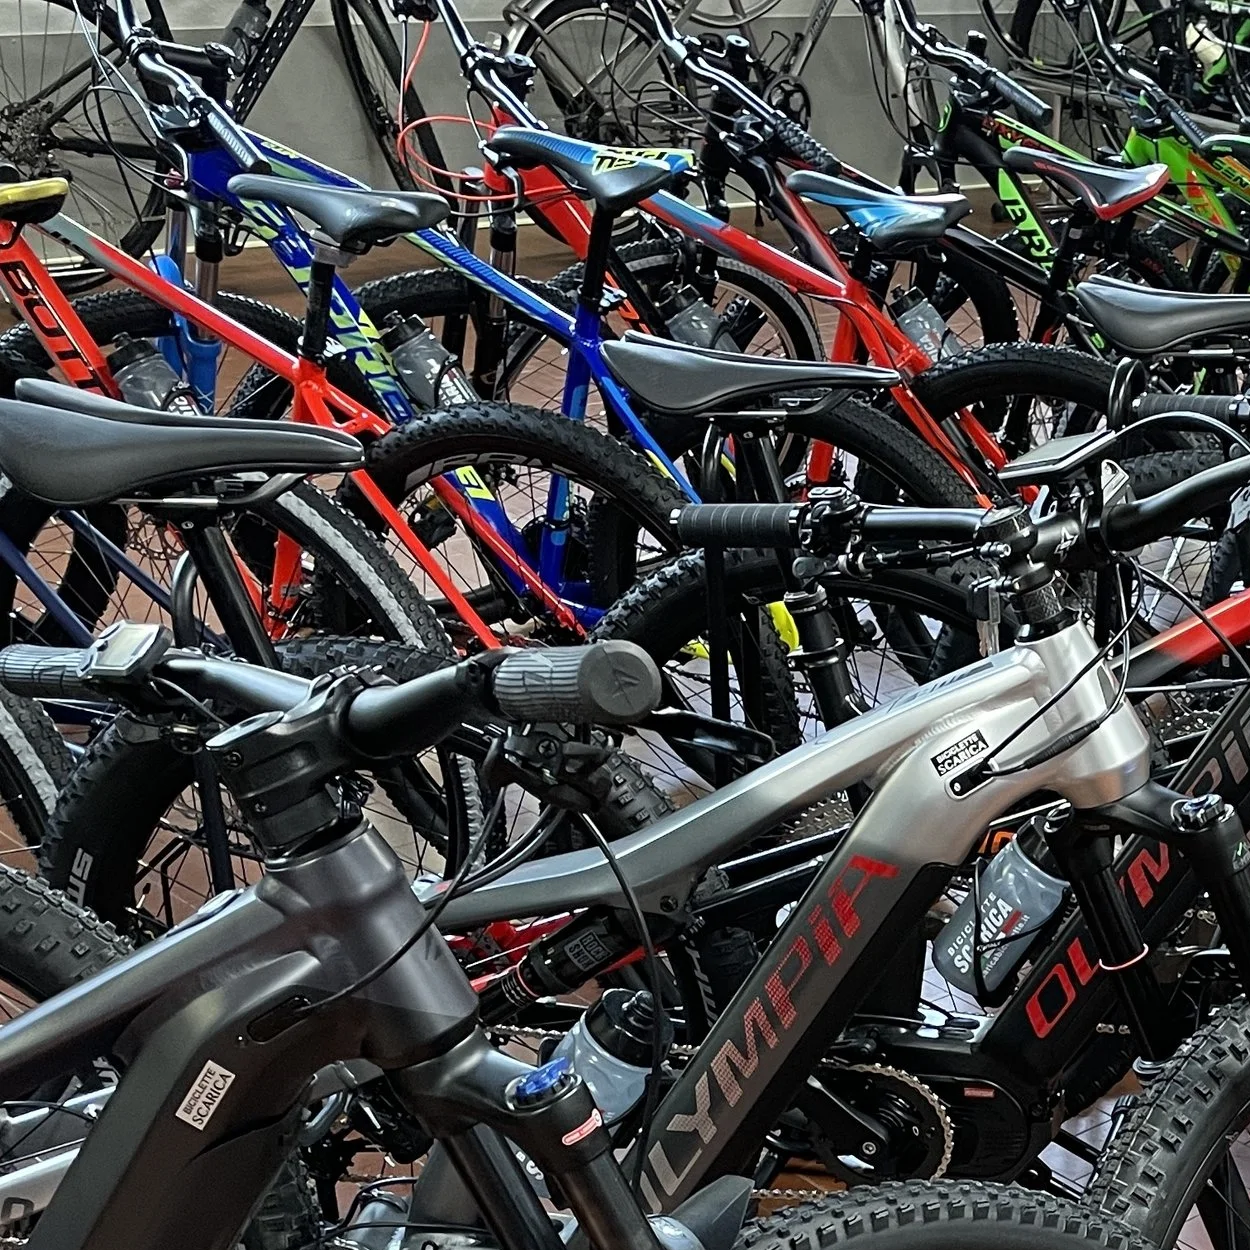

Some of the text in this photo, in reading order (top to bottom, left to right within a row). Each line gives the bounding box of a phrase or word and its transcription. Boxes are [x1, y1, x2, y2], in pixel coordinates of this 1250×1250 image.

[938, 741, 987, 775] SCARICA
[581, 931, 608, 961] ROCK
[953, 898, 1013, 974] SCRICA
[182, 1066, 217, 1116] BICICLETTE
[191, 1072, 233, 1125] SCARICA
